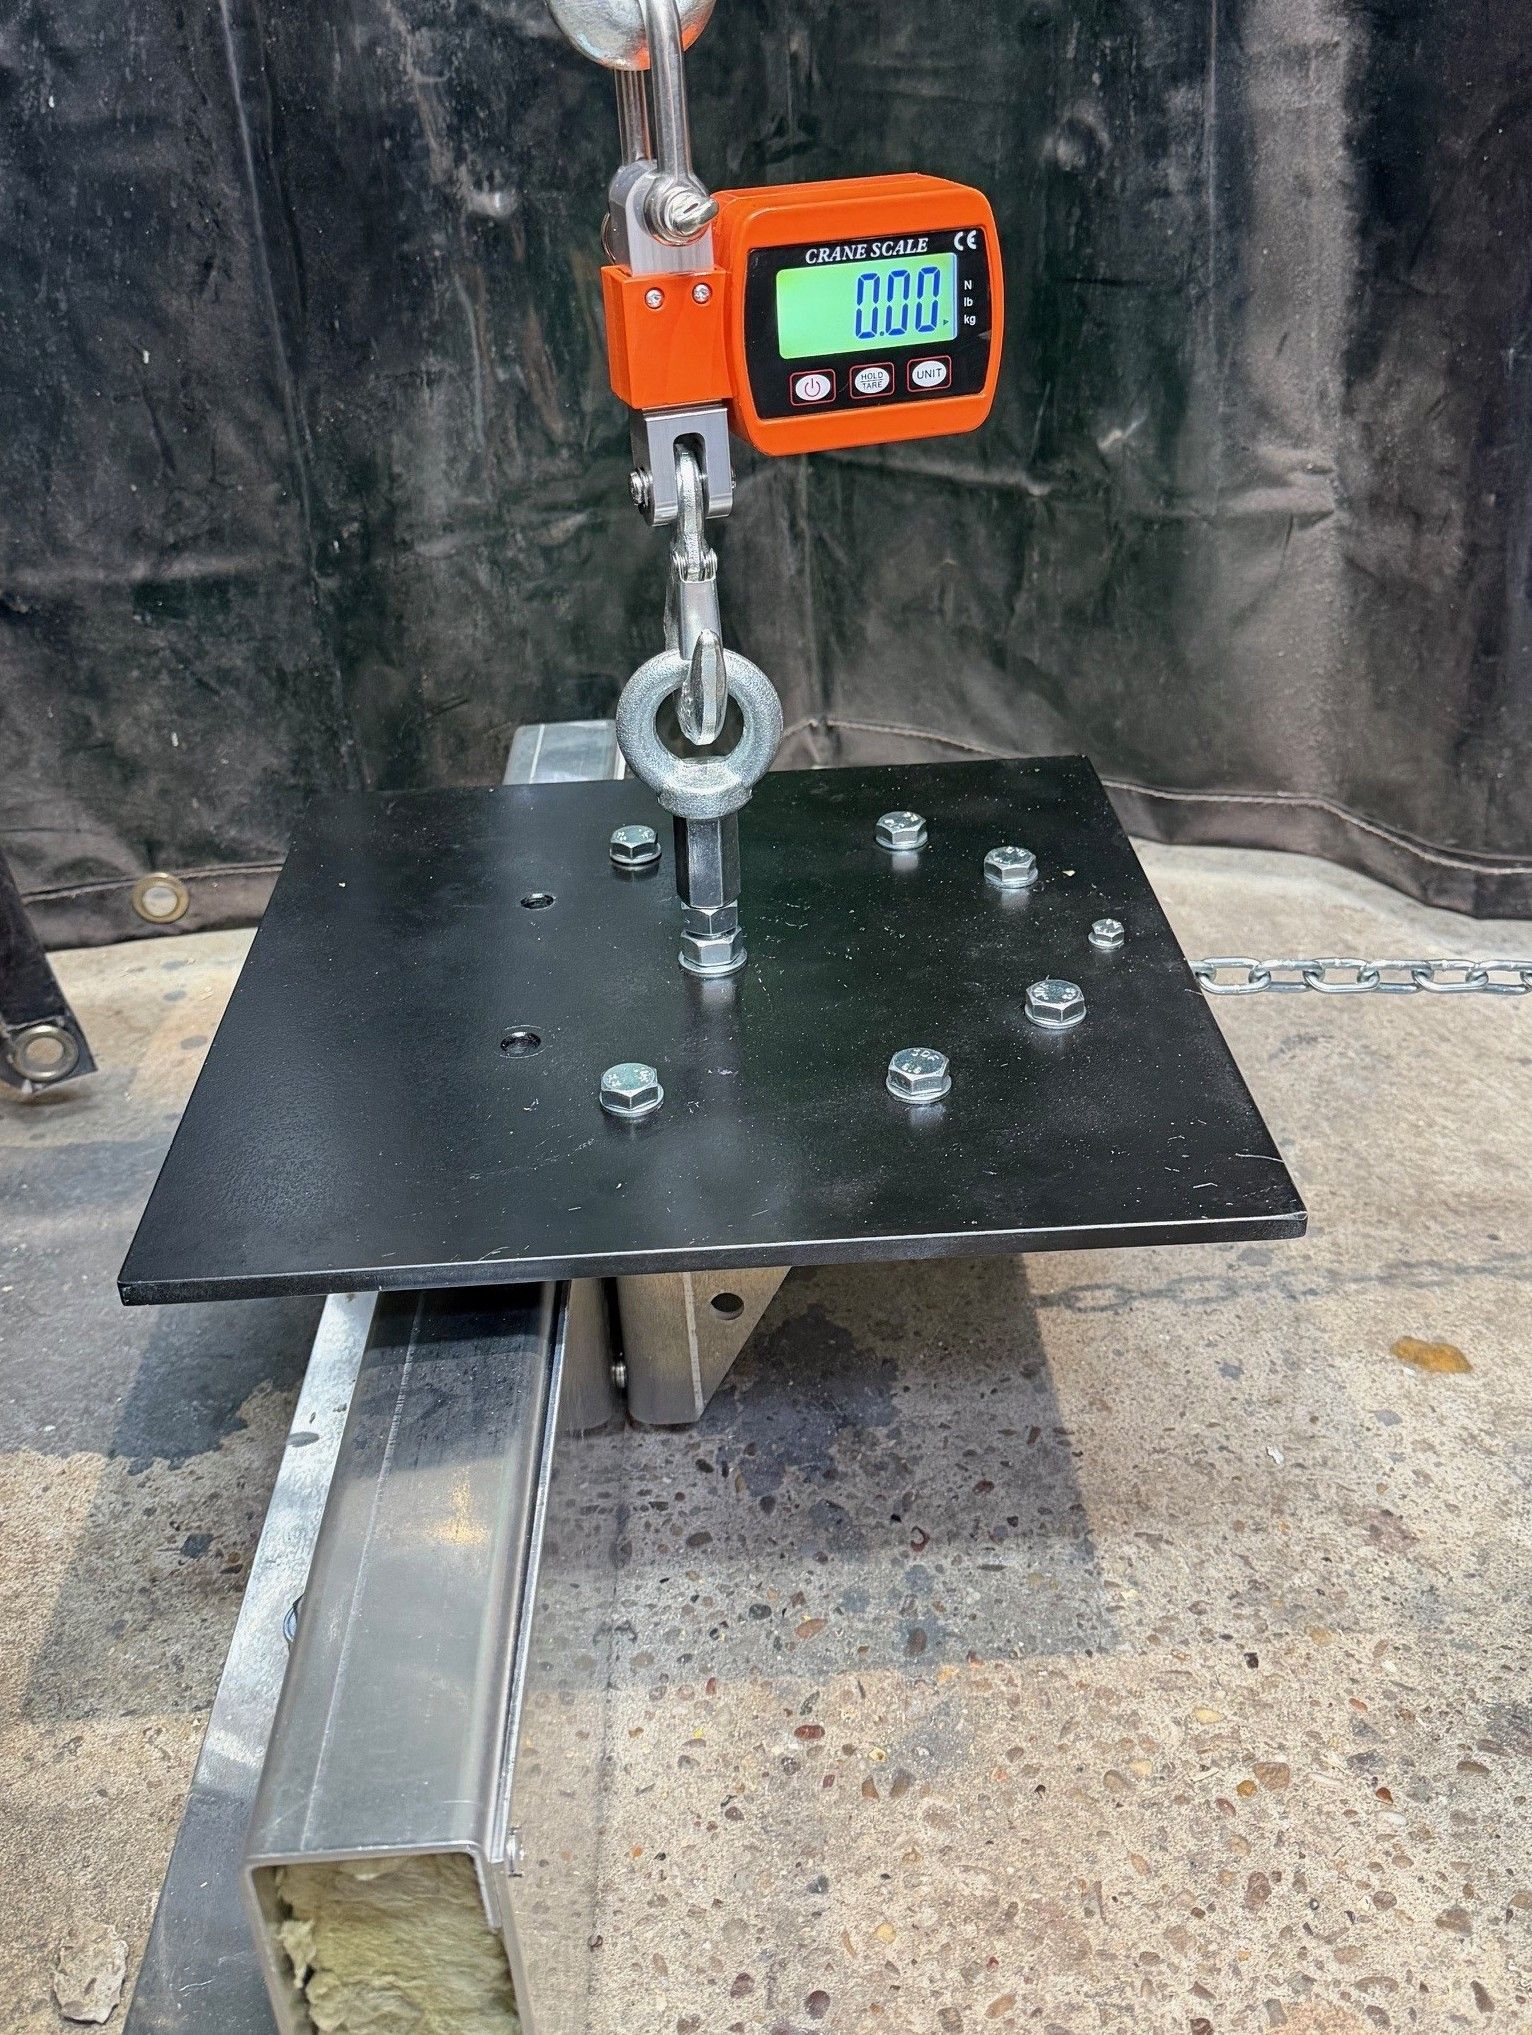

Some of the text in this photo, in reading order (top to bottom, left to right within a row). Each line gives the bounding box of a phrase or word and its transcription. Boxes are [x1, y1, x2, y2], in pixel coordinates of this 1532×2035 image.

[954, 230, 977, 251] CE
[805, 238, 929, 264] CRANE SCALE
[964, 280, 972, 290] N
[855, 266, 941, 340] 0.00
[964, 297, 974, 307] lb
[964, 315, 976, 326] kg
[861, 371, 885, 381] HOLD
[916, 367, 942, 380] UNIT
[862, 381, 883, 390] TARE
